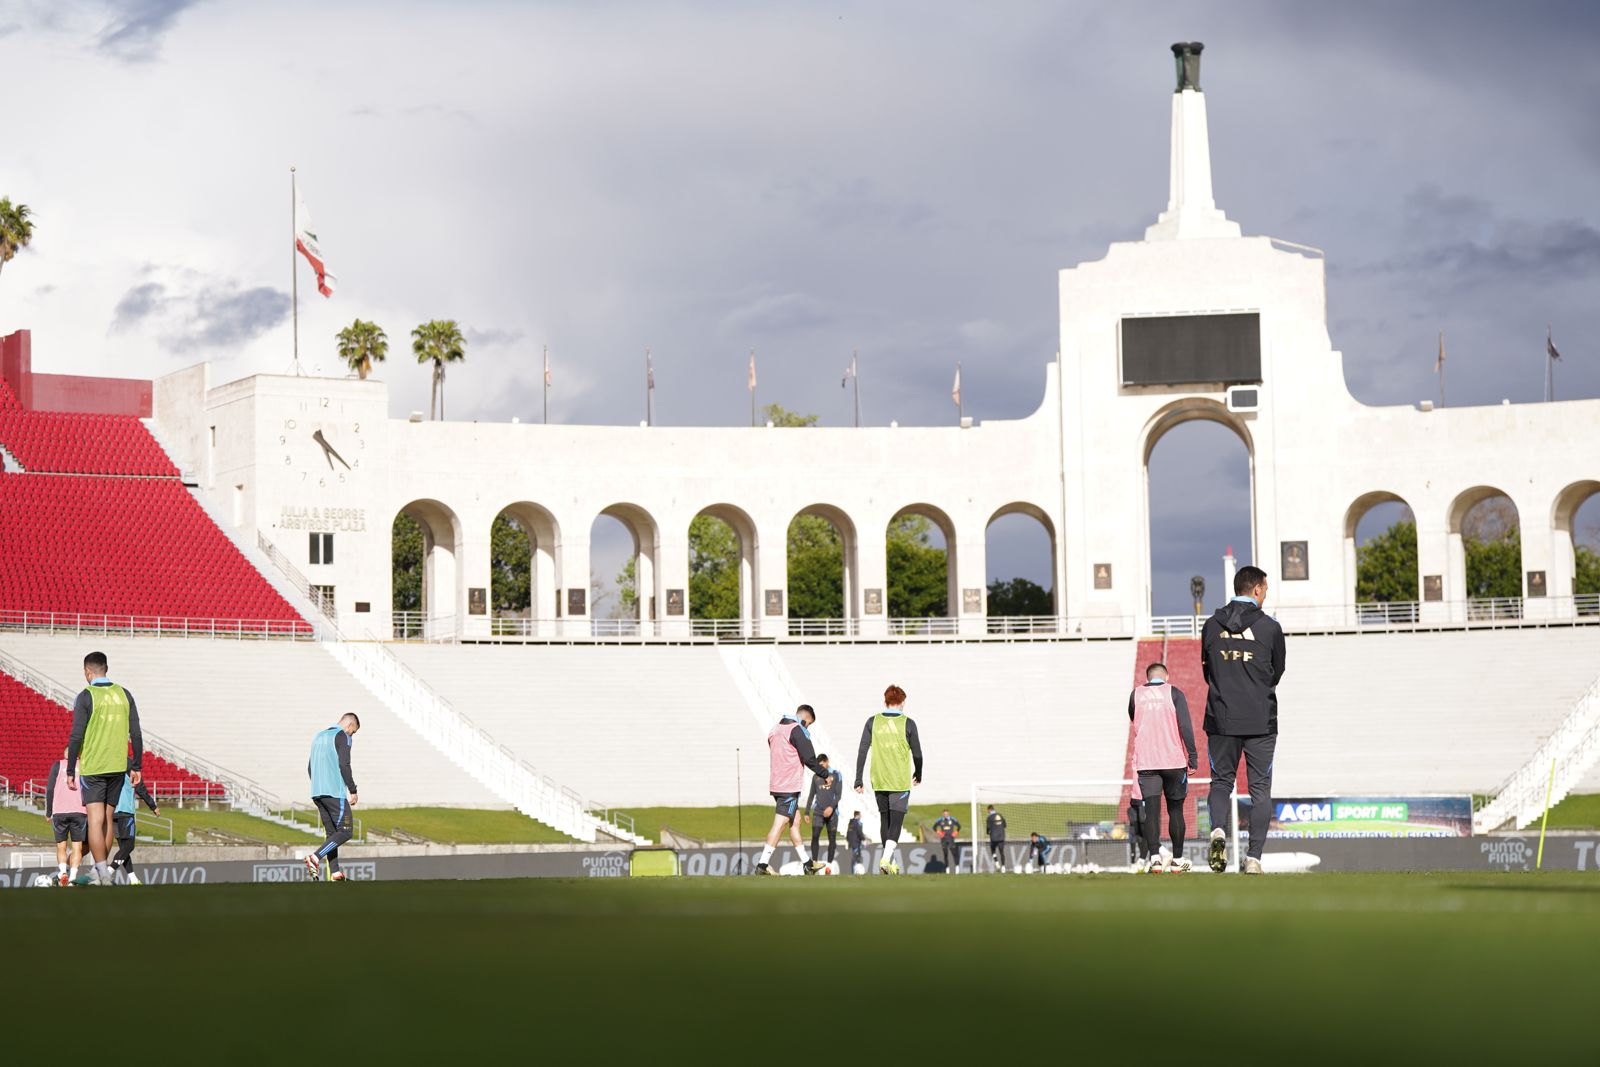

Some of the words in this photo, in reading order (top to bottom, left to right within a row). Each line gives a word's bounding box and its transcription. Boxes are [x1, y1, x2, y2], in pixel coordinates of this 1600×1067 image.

[319, 397, 329, 408] 12
[284, 418, 297, 430] 10
[338, 472, 346, 483] 5
[1220, 650, 1253, 662] YPF
[1279, 803, 1332, 821] AGM
[1336, 805, 1376, 819] SPORT
[1381, 805, 1404, 818] INC
[1480, 842, 1525, 853] PUNTO
[582, 856, 624, 868] PUNTO
[1488, 852, 1526, 864] FINAL
[258, 866, 288, 882] FOX
